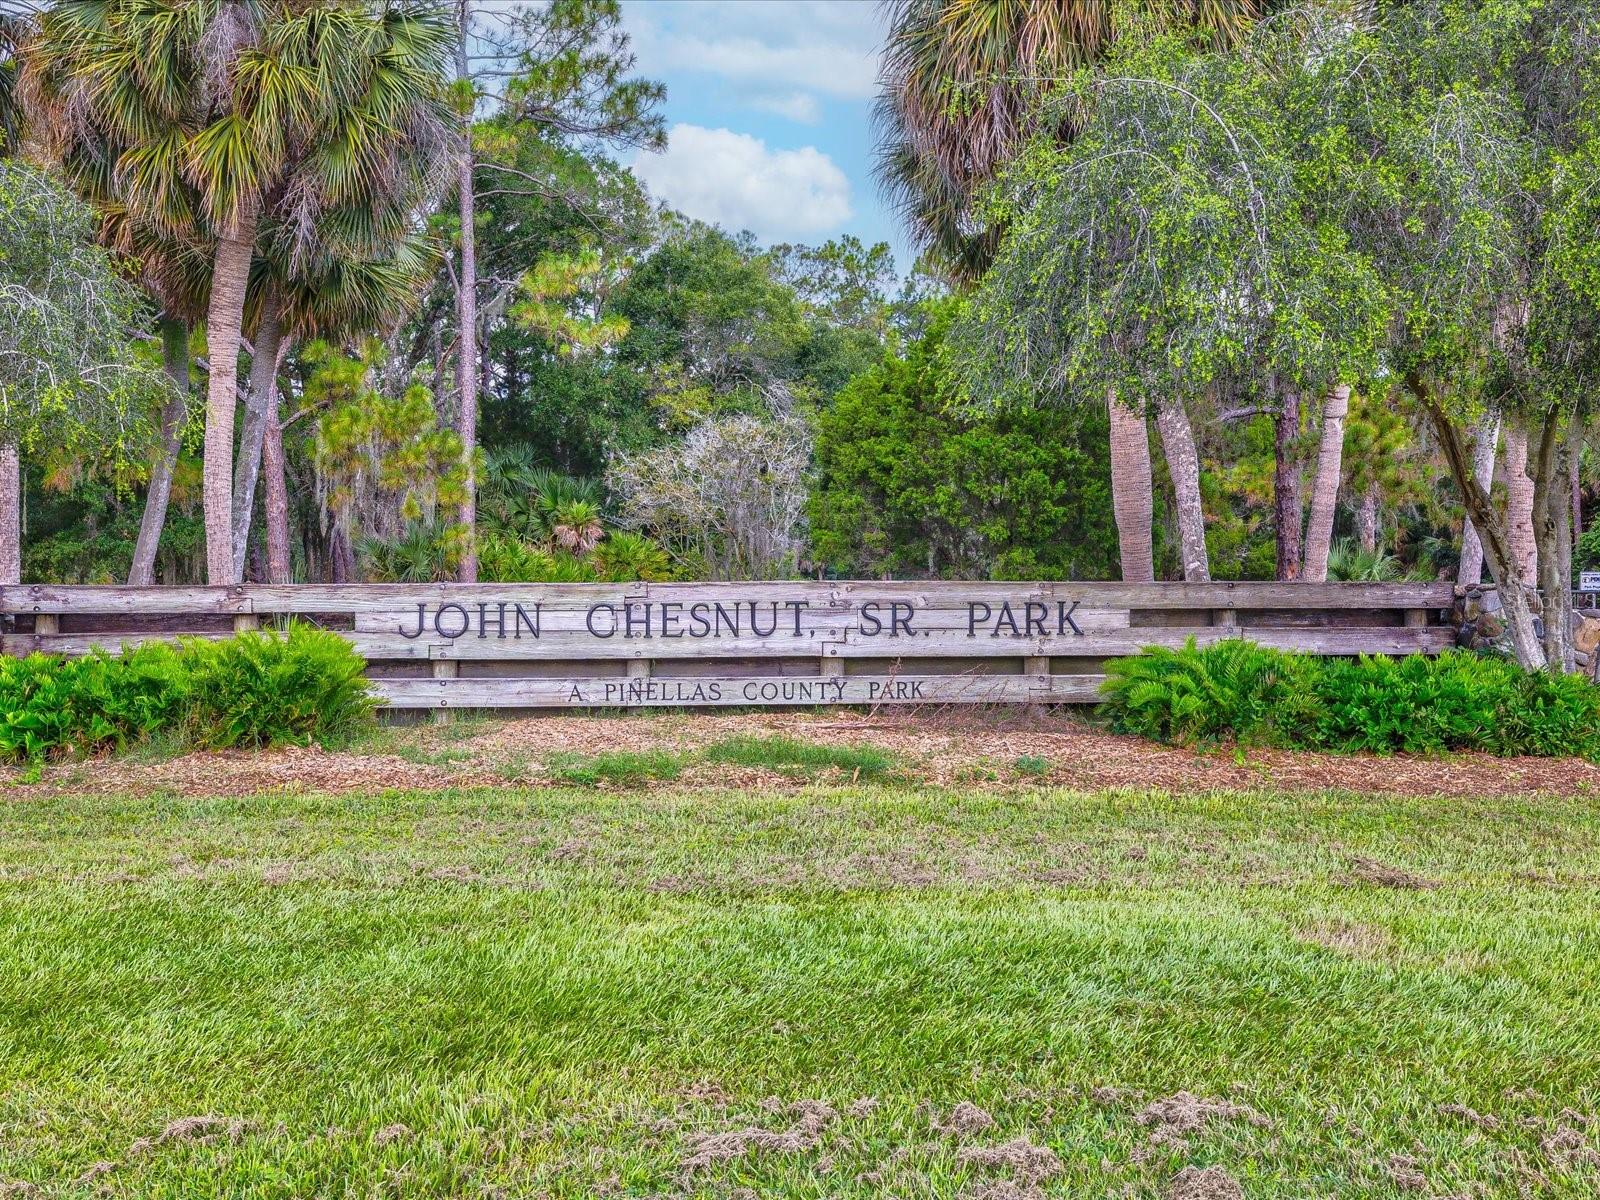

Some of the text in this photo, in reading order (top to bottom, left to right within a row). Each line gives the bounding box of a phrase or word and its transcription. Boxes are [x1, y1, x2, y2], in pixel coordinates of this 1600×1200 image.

[398, 600, 1085, 640] JOHN CHESNUT, SR. PARK
[568, 680, 927, 703] A PINELLAS COUNTY PARK
